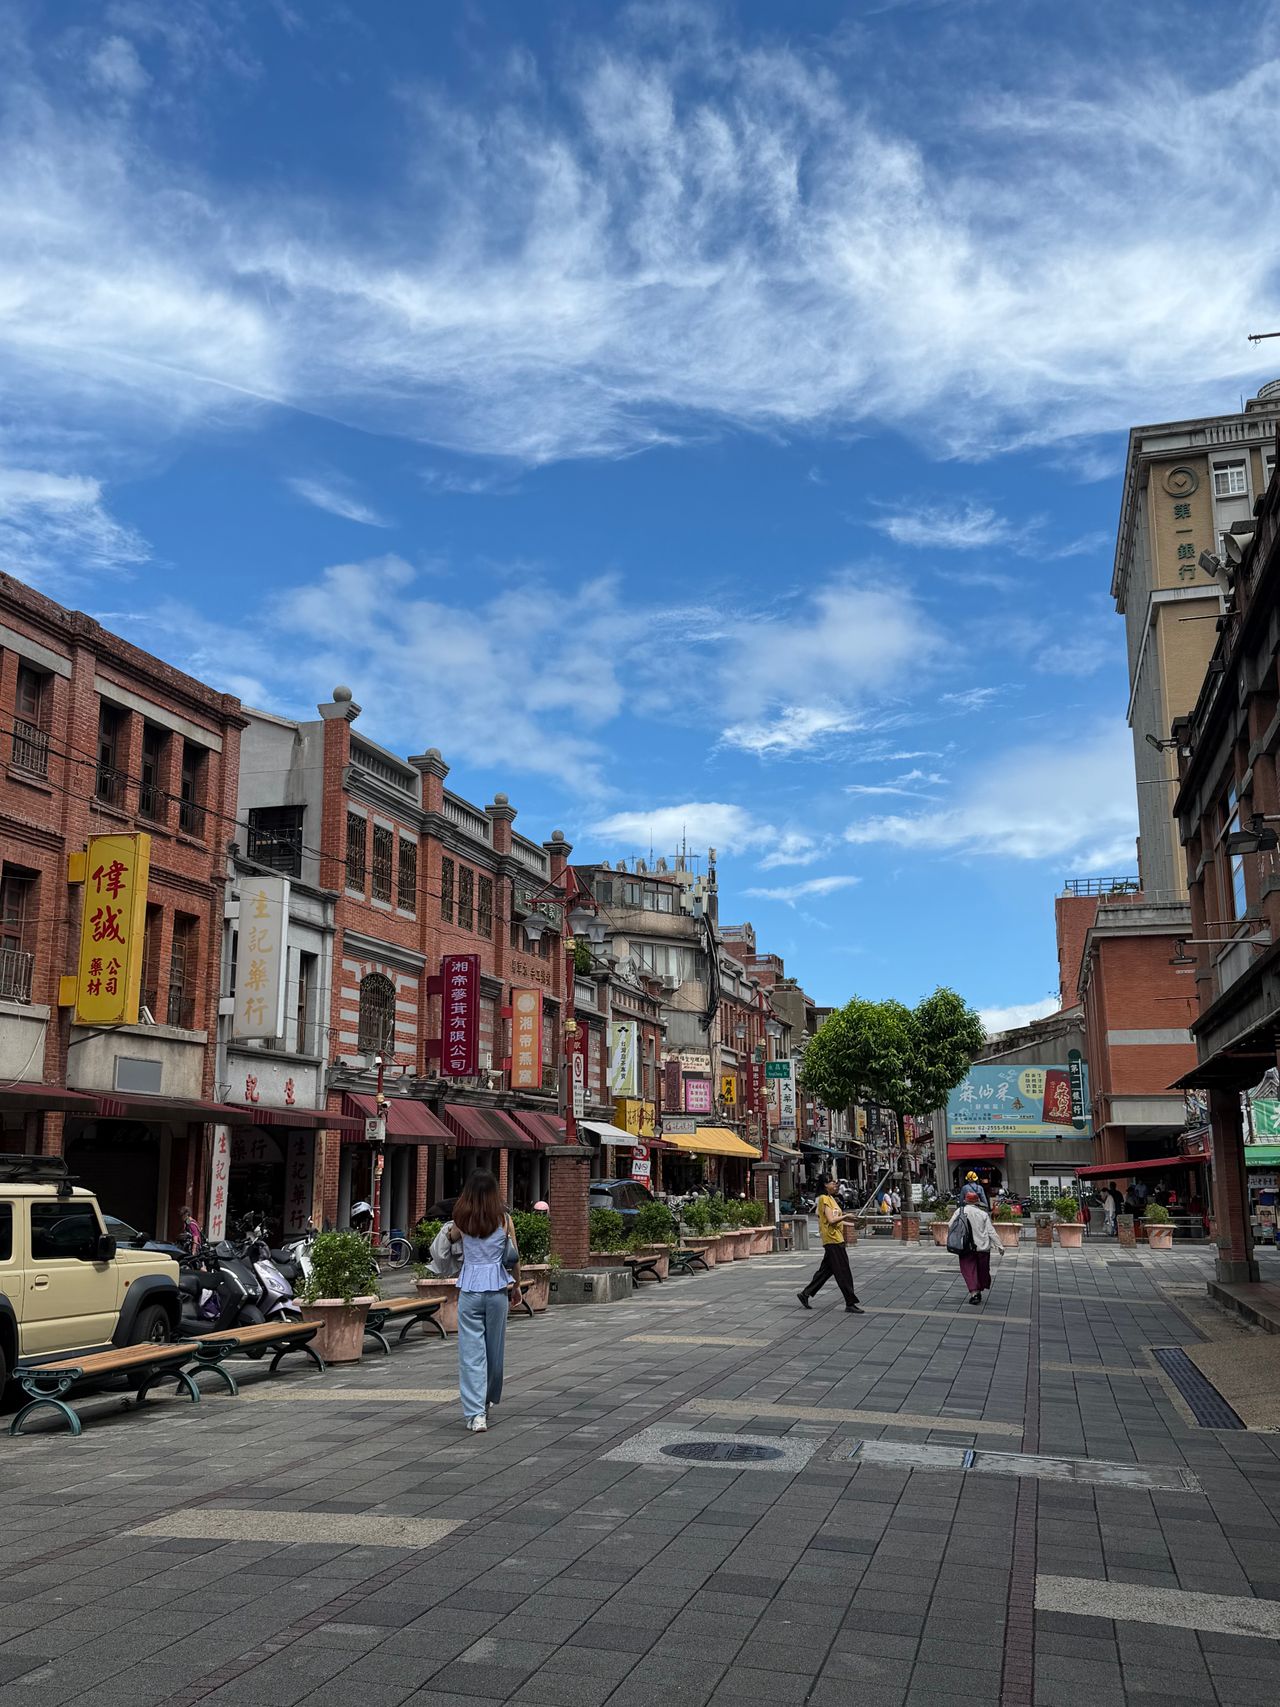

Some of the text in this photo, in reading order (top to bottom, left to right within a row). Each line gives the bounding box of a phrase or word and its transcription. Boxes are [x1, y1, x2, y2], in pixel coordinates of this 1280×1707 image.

[1174, 504, 1196, 580] 第一銀行
[90, 860, 129, 945] 偉誠
[105, 957, 121, 996] 公司
[243, 890, 273, 1026] 生記藥行
[1070, 1064, 1081, 1115] 第一銀行
[212, 1132, 227, 1237] 生記藥行
[290, 1137, 308, 1229] 生記藥行
